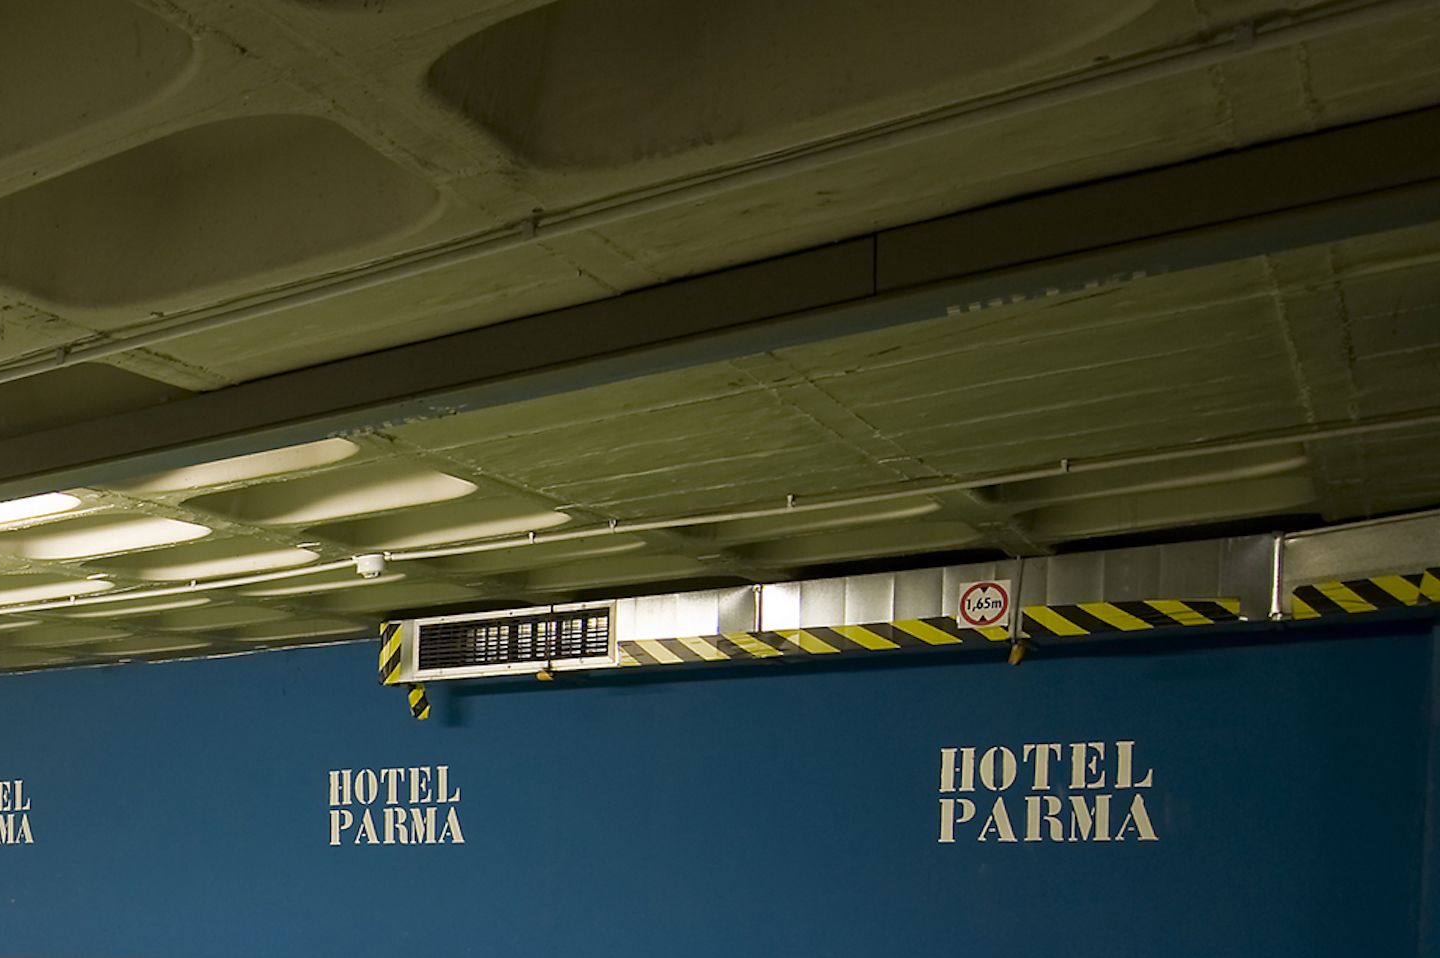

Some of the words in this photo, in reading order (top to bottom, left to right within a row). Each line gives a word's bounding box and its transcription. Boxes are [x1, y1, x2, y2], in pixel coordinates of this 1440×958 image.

[966, 597, 1002, 612] 1,65m
[329, 766, 460, 806] HOTEL
[939, 741, 1153, 792] HOTEL
[329, 807, 465, 846] PARMA
[938, 794, 1159, 843] PARMA
